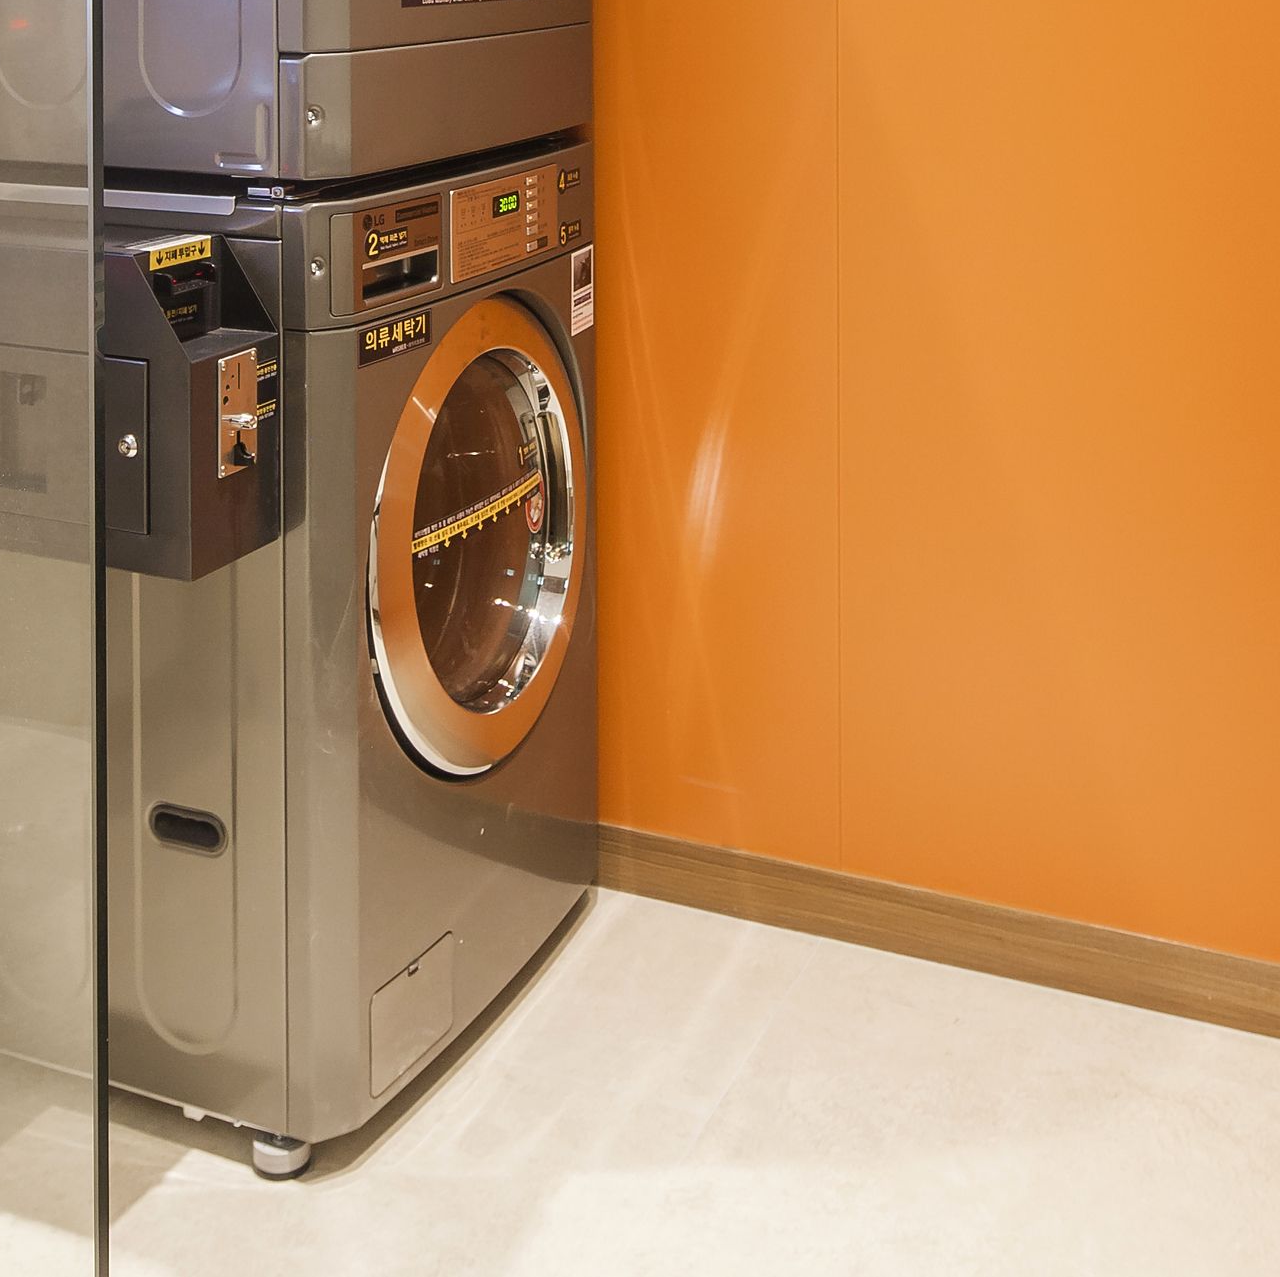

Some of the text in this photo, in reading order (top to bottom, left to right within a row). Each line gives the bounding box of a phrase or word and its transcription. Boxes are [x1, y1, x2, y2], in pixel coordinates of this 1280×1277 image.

[559, 172, 565, 190] 4
[374, 214, 385, 226] LG
[368, 233, 379, 256] 2
[560, 226, 566, 245] 5
[165, 245, 197, 261] 지폐투입구
